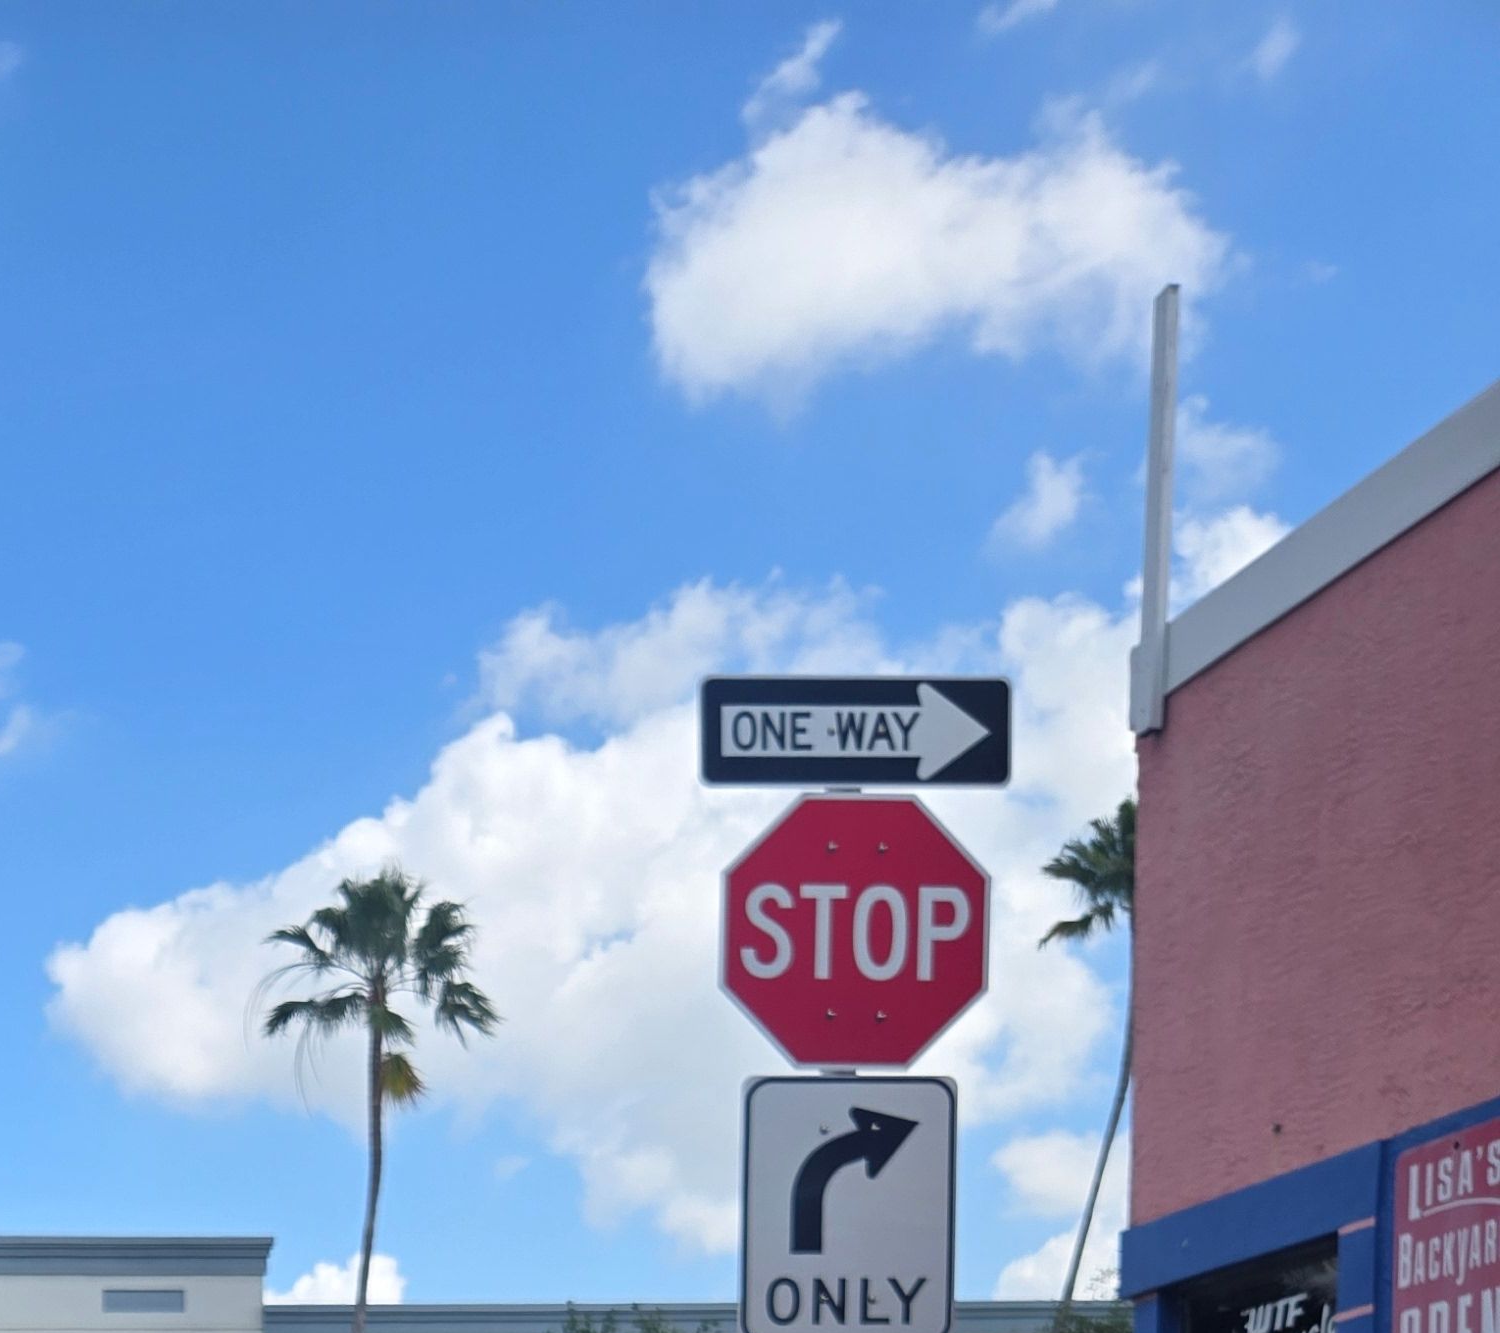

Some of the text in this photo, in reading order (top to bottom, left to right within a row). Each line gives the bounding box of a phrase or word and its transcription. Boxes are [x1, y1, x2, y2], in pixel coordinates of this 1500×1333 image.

[732, 710, 921, 752] ONE WAY
[740, 882, 972, 982] STOP
[1397, 1218, 1500, 1289] BACKYAR
[765, 1276, 927, 1326] ONLY
